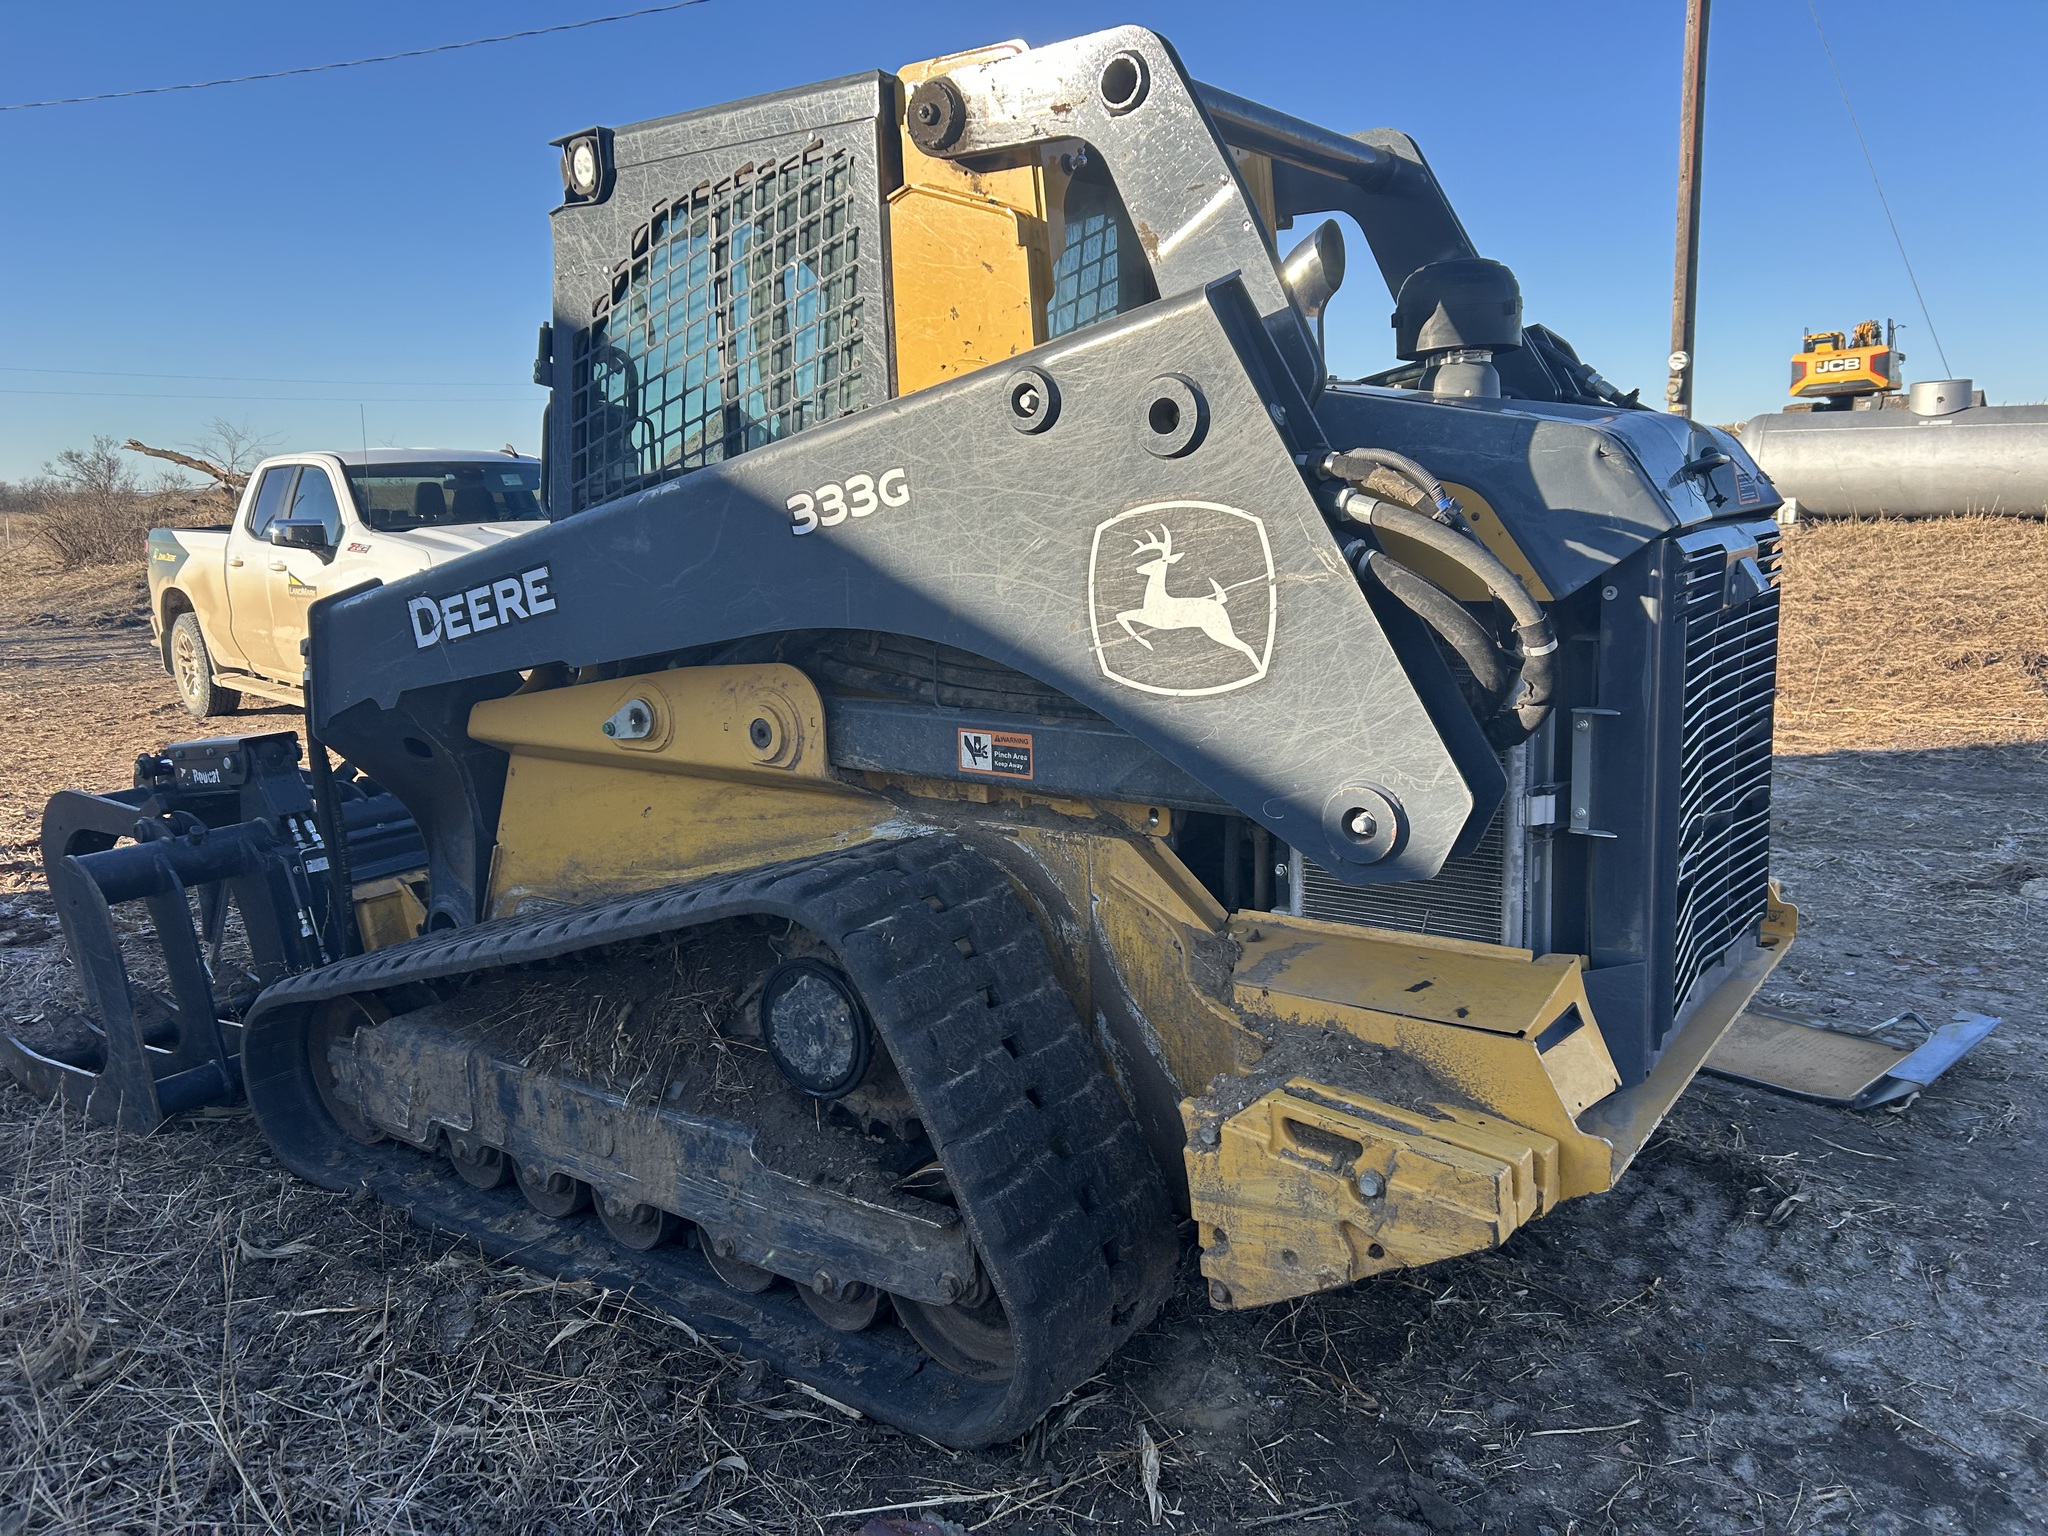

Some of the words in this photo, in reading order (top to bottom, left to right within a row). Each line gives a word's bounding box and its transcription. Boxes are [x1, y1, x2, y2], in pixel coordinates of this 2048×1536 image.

[1816, 358, 1860, 373] JCB
[786, 468, 911, 535] 333G
[407, 566, 556, 649] DEERE
[1000, 736, 1028, 744] WARNING
[994, 750, 1012, 760] Pinch
[1013, 753, 1028, 761] Area
[994, 760, 1008, 768] Keep
[1009, 761, 1024, 770] Away
